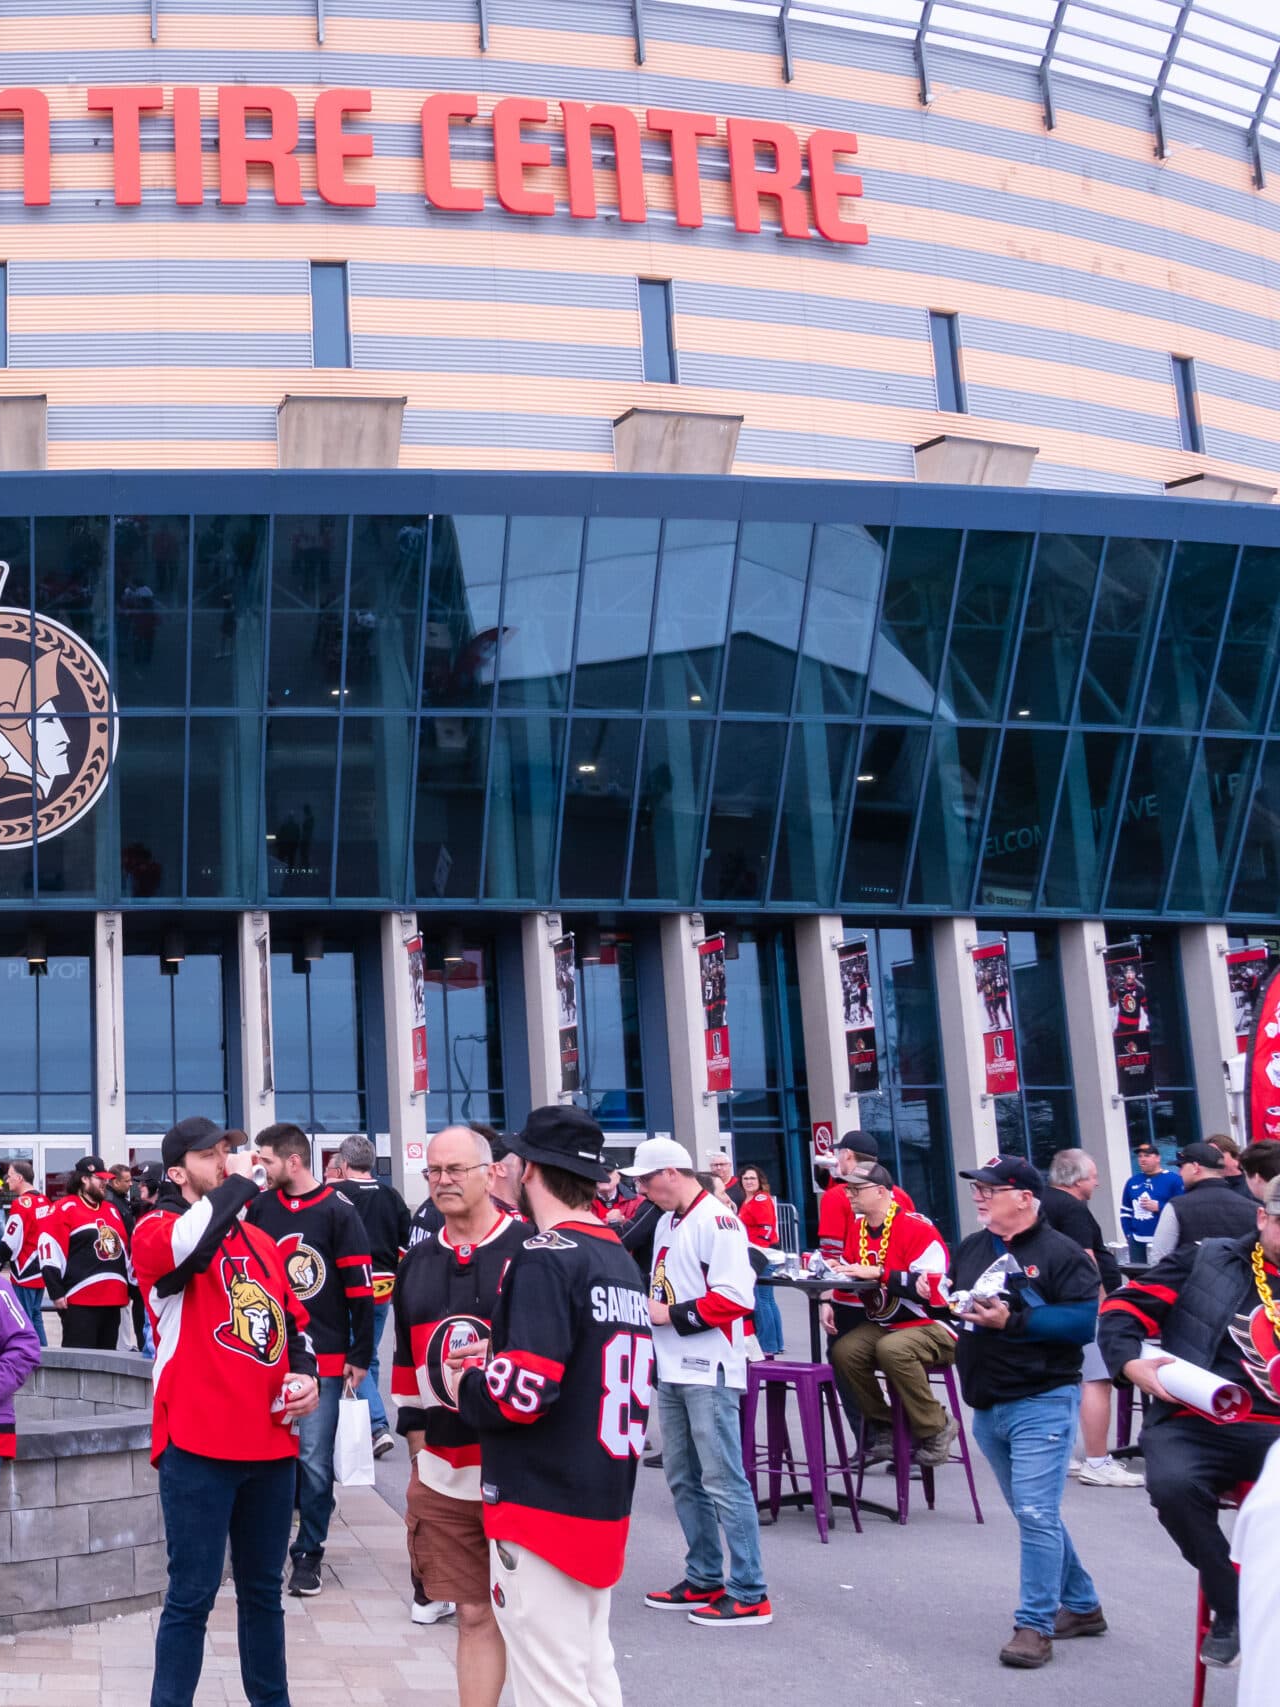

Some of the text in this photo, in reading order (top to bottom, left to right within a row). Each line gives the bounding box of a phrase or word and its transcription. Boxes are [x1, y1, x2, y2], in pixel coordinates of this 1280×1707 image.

[86, 85, 377, 207] TIRE
[419, 92, 869, 246] CENTRE
[6, 1221, 18, 1236] 6
[38, 1243, 52, 1260] 11
[485, 1356, 547, 1414] 85
[598, 1330, 654, 1460] 85
